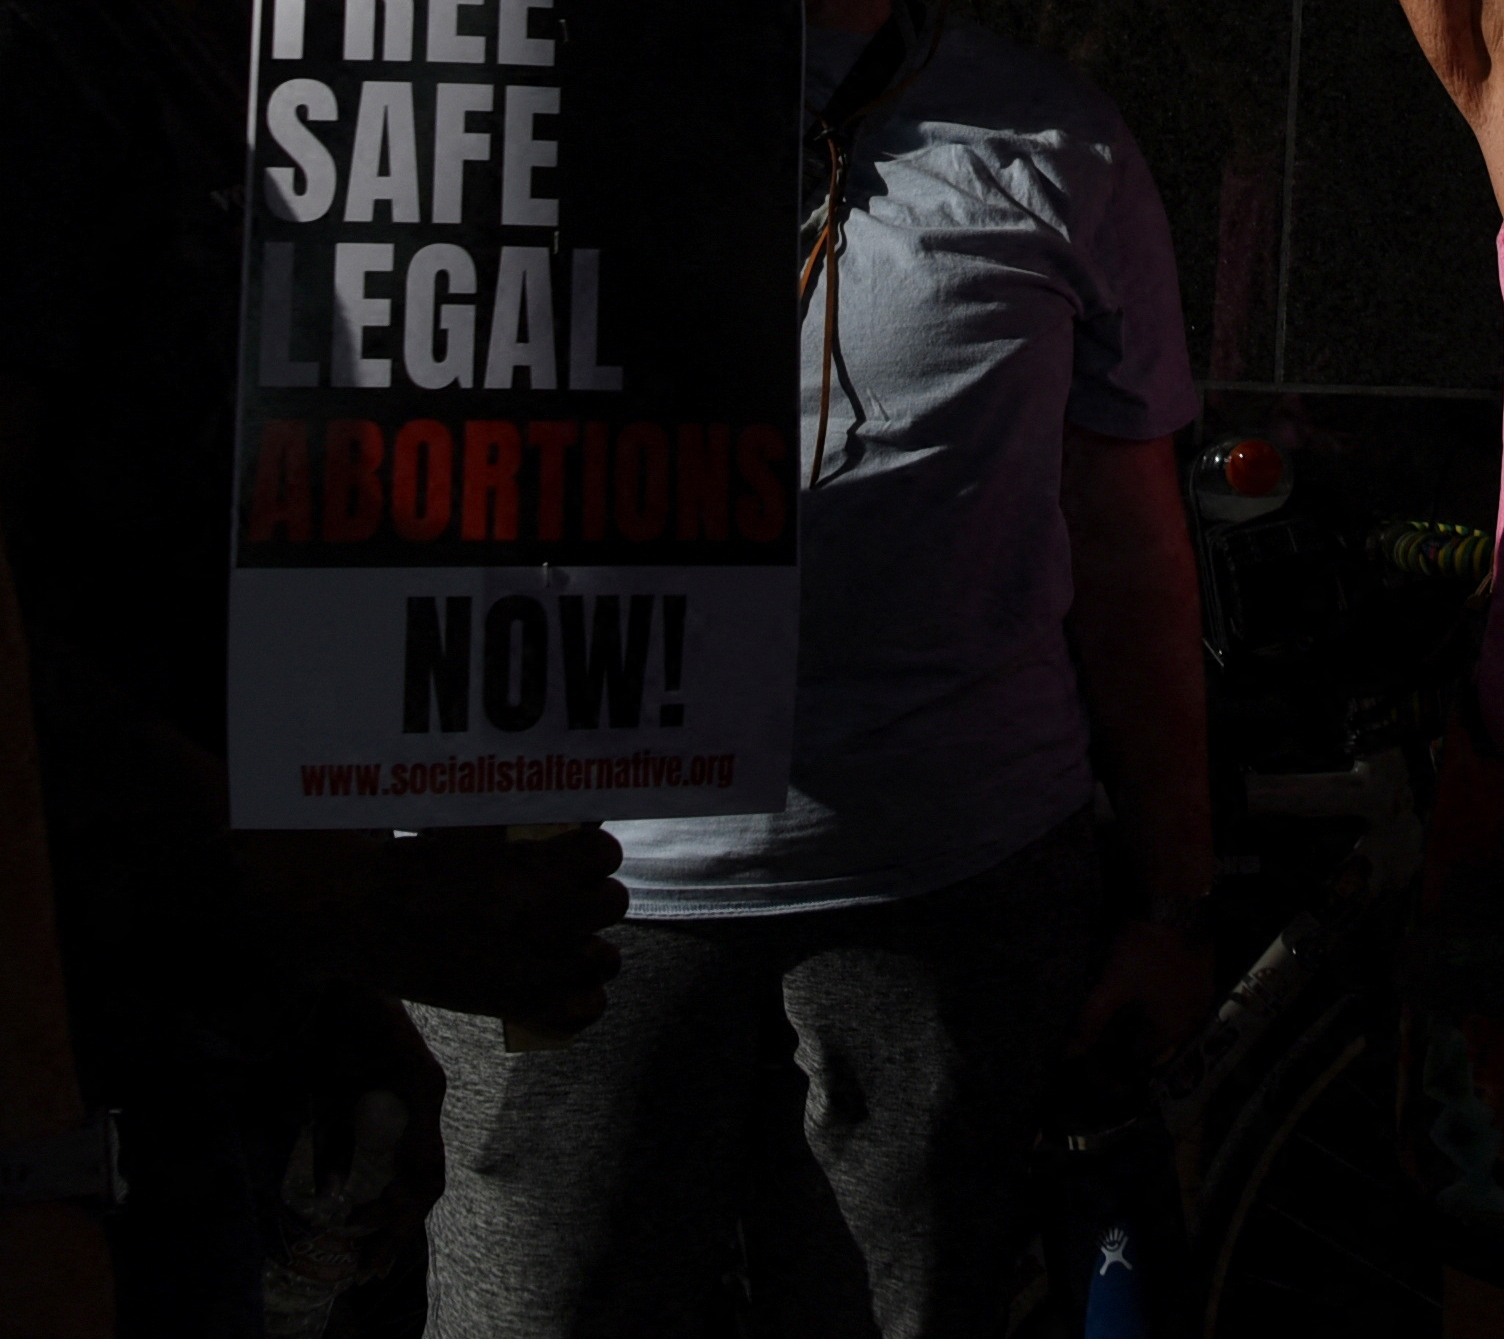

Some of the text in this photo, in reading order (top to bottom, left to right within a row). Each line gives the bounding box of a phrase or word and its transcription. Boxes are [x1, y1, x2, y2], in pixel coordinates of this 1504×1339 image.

[262, 77, 563, 229] SAFE
[256, 241, 625, 393] LEGAL
[246, 417, 789, 546] ABORTIONS
[402, 595, 688, 736] NOW!
[301, 750, 736, 798] www.socialistalternative.org
